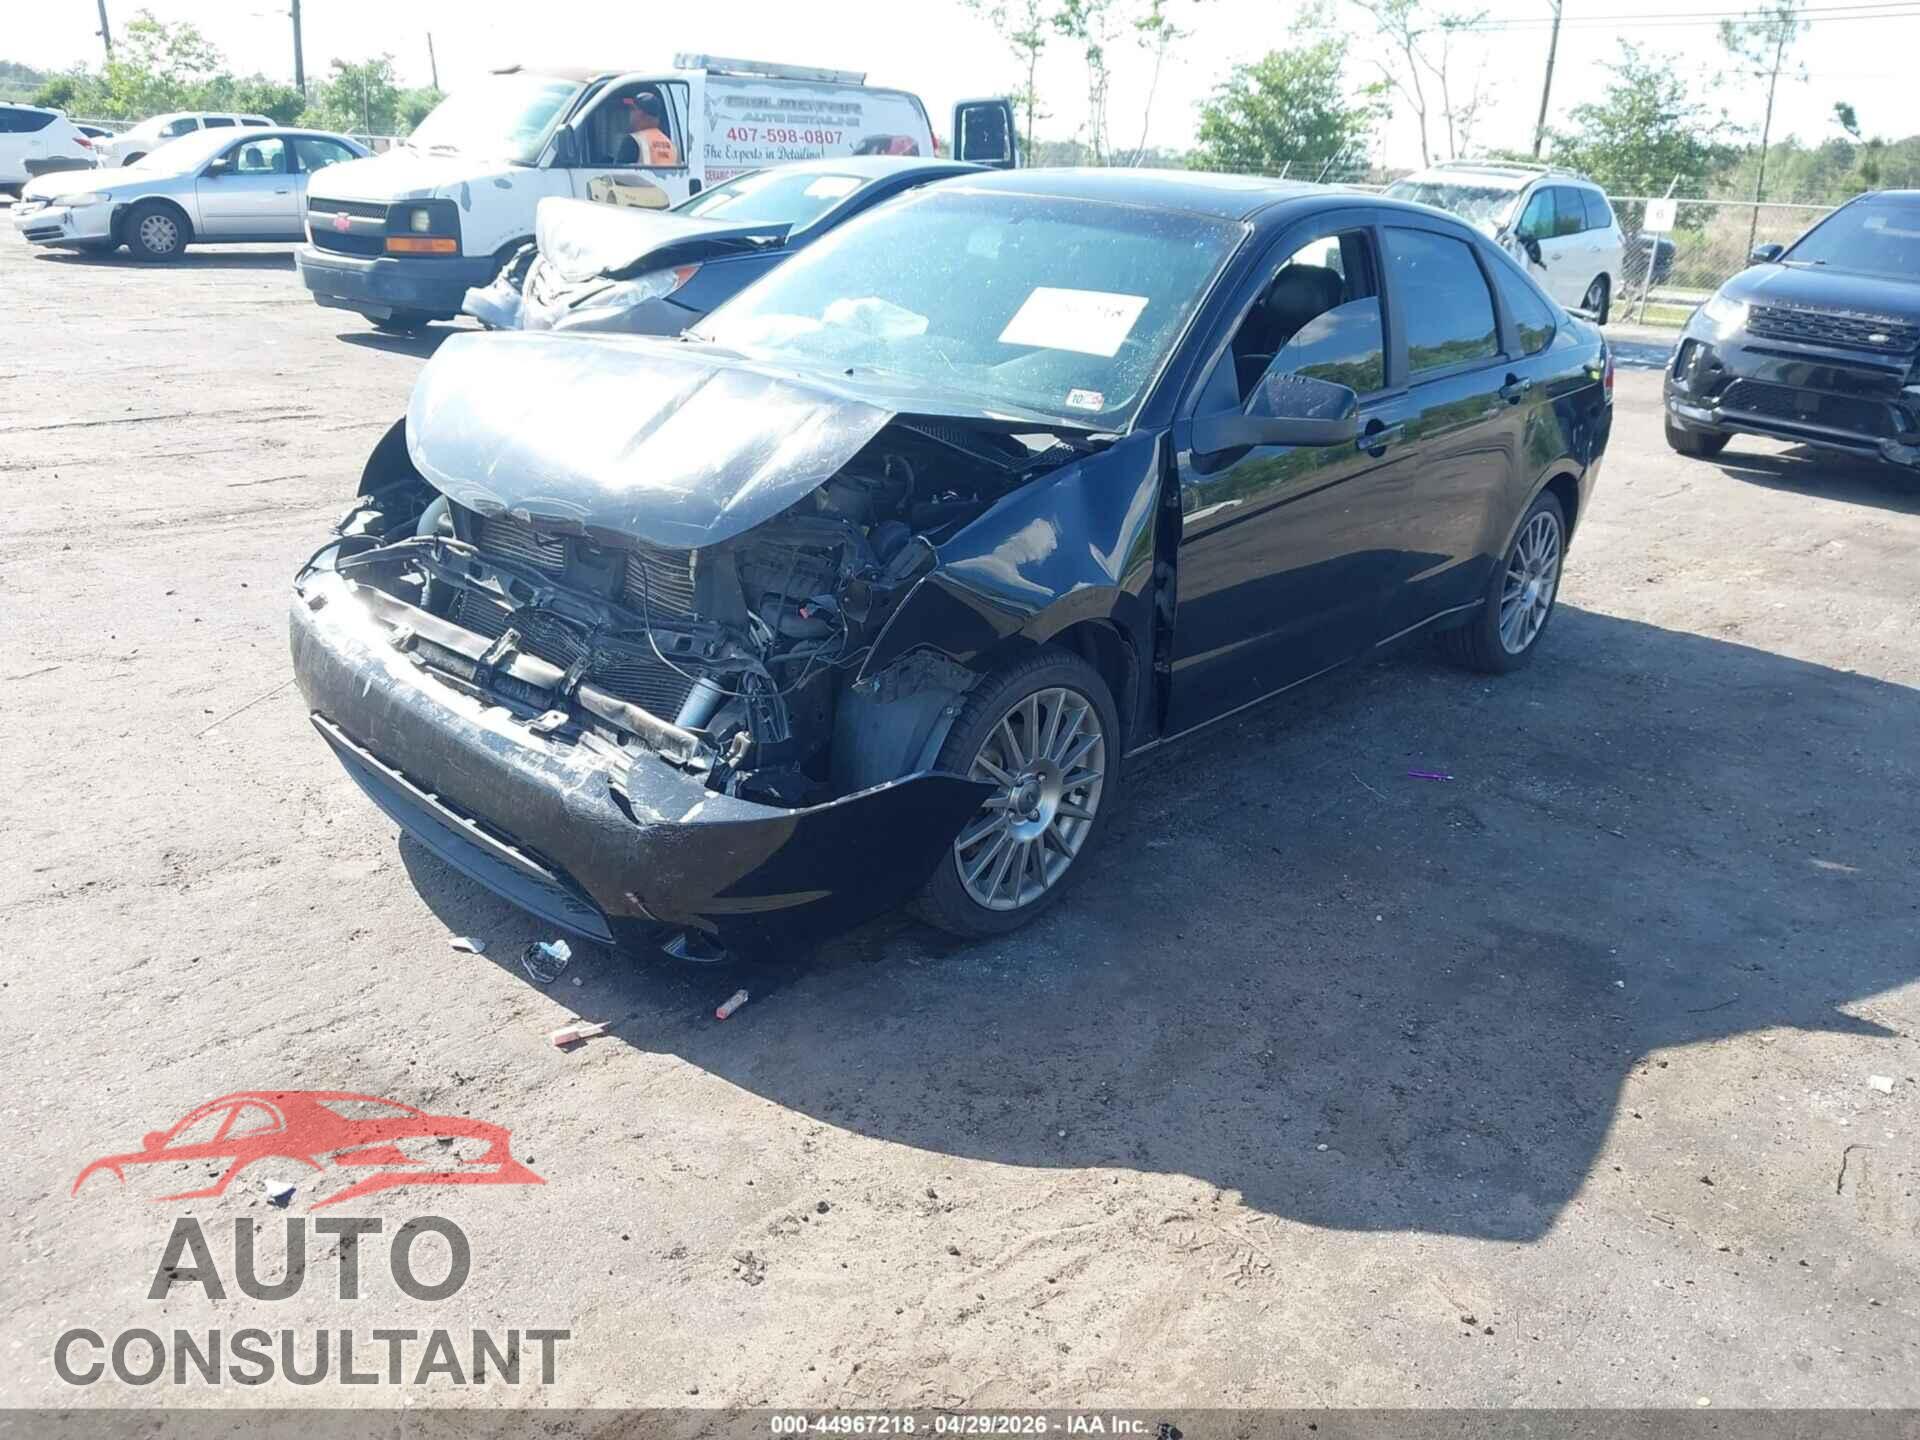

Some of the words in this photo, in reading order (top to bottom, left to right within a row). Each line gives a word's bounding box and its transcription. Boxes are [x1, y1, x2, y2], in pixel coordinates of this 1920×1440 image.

[727, 127, 843, 145] 407-598-0807
[704, 144, 722, 160] The
[765, 151, 775, 160] in
